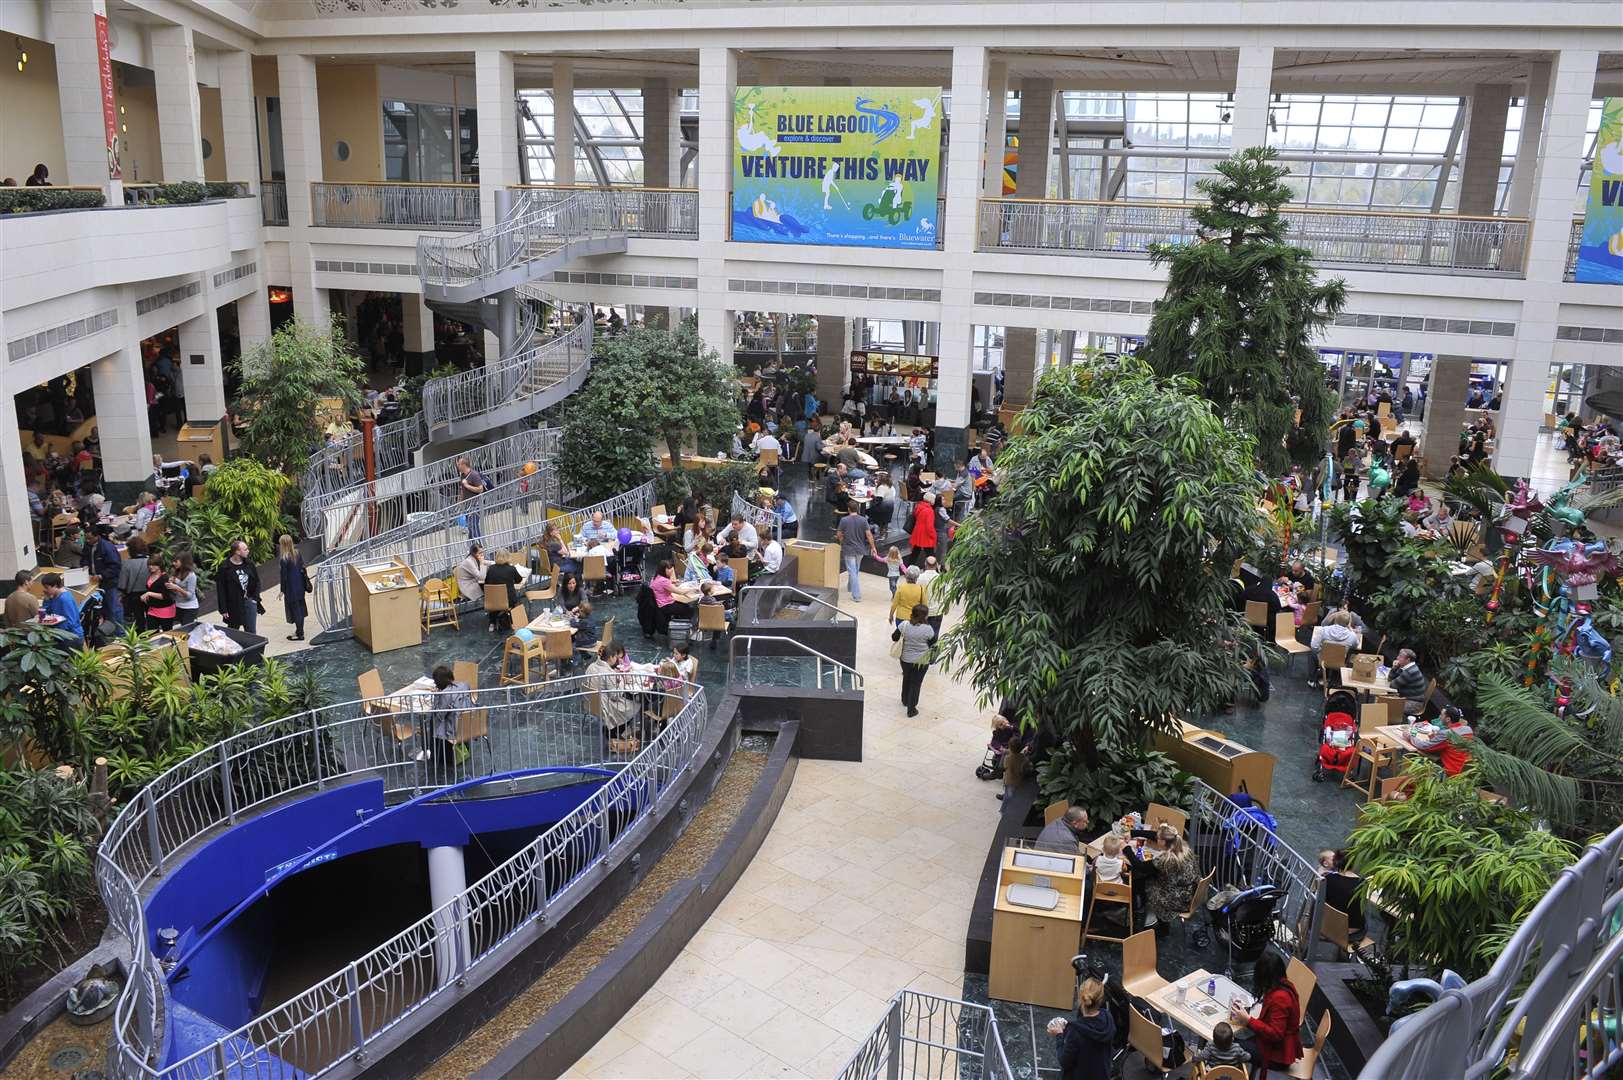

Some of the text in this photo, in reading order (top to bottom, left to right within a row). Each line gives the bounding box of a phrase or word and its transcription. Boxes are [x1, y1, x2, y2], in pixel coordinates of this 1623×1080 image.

[777, 114, 881, 134] BLUE LAGOON
[811, 135, 835, 143] discover
[741, 155, 930, 182] VENTURE THIS WAY
[899, 233, 935, 241] Bluewater
